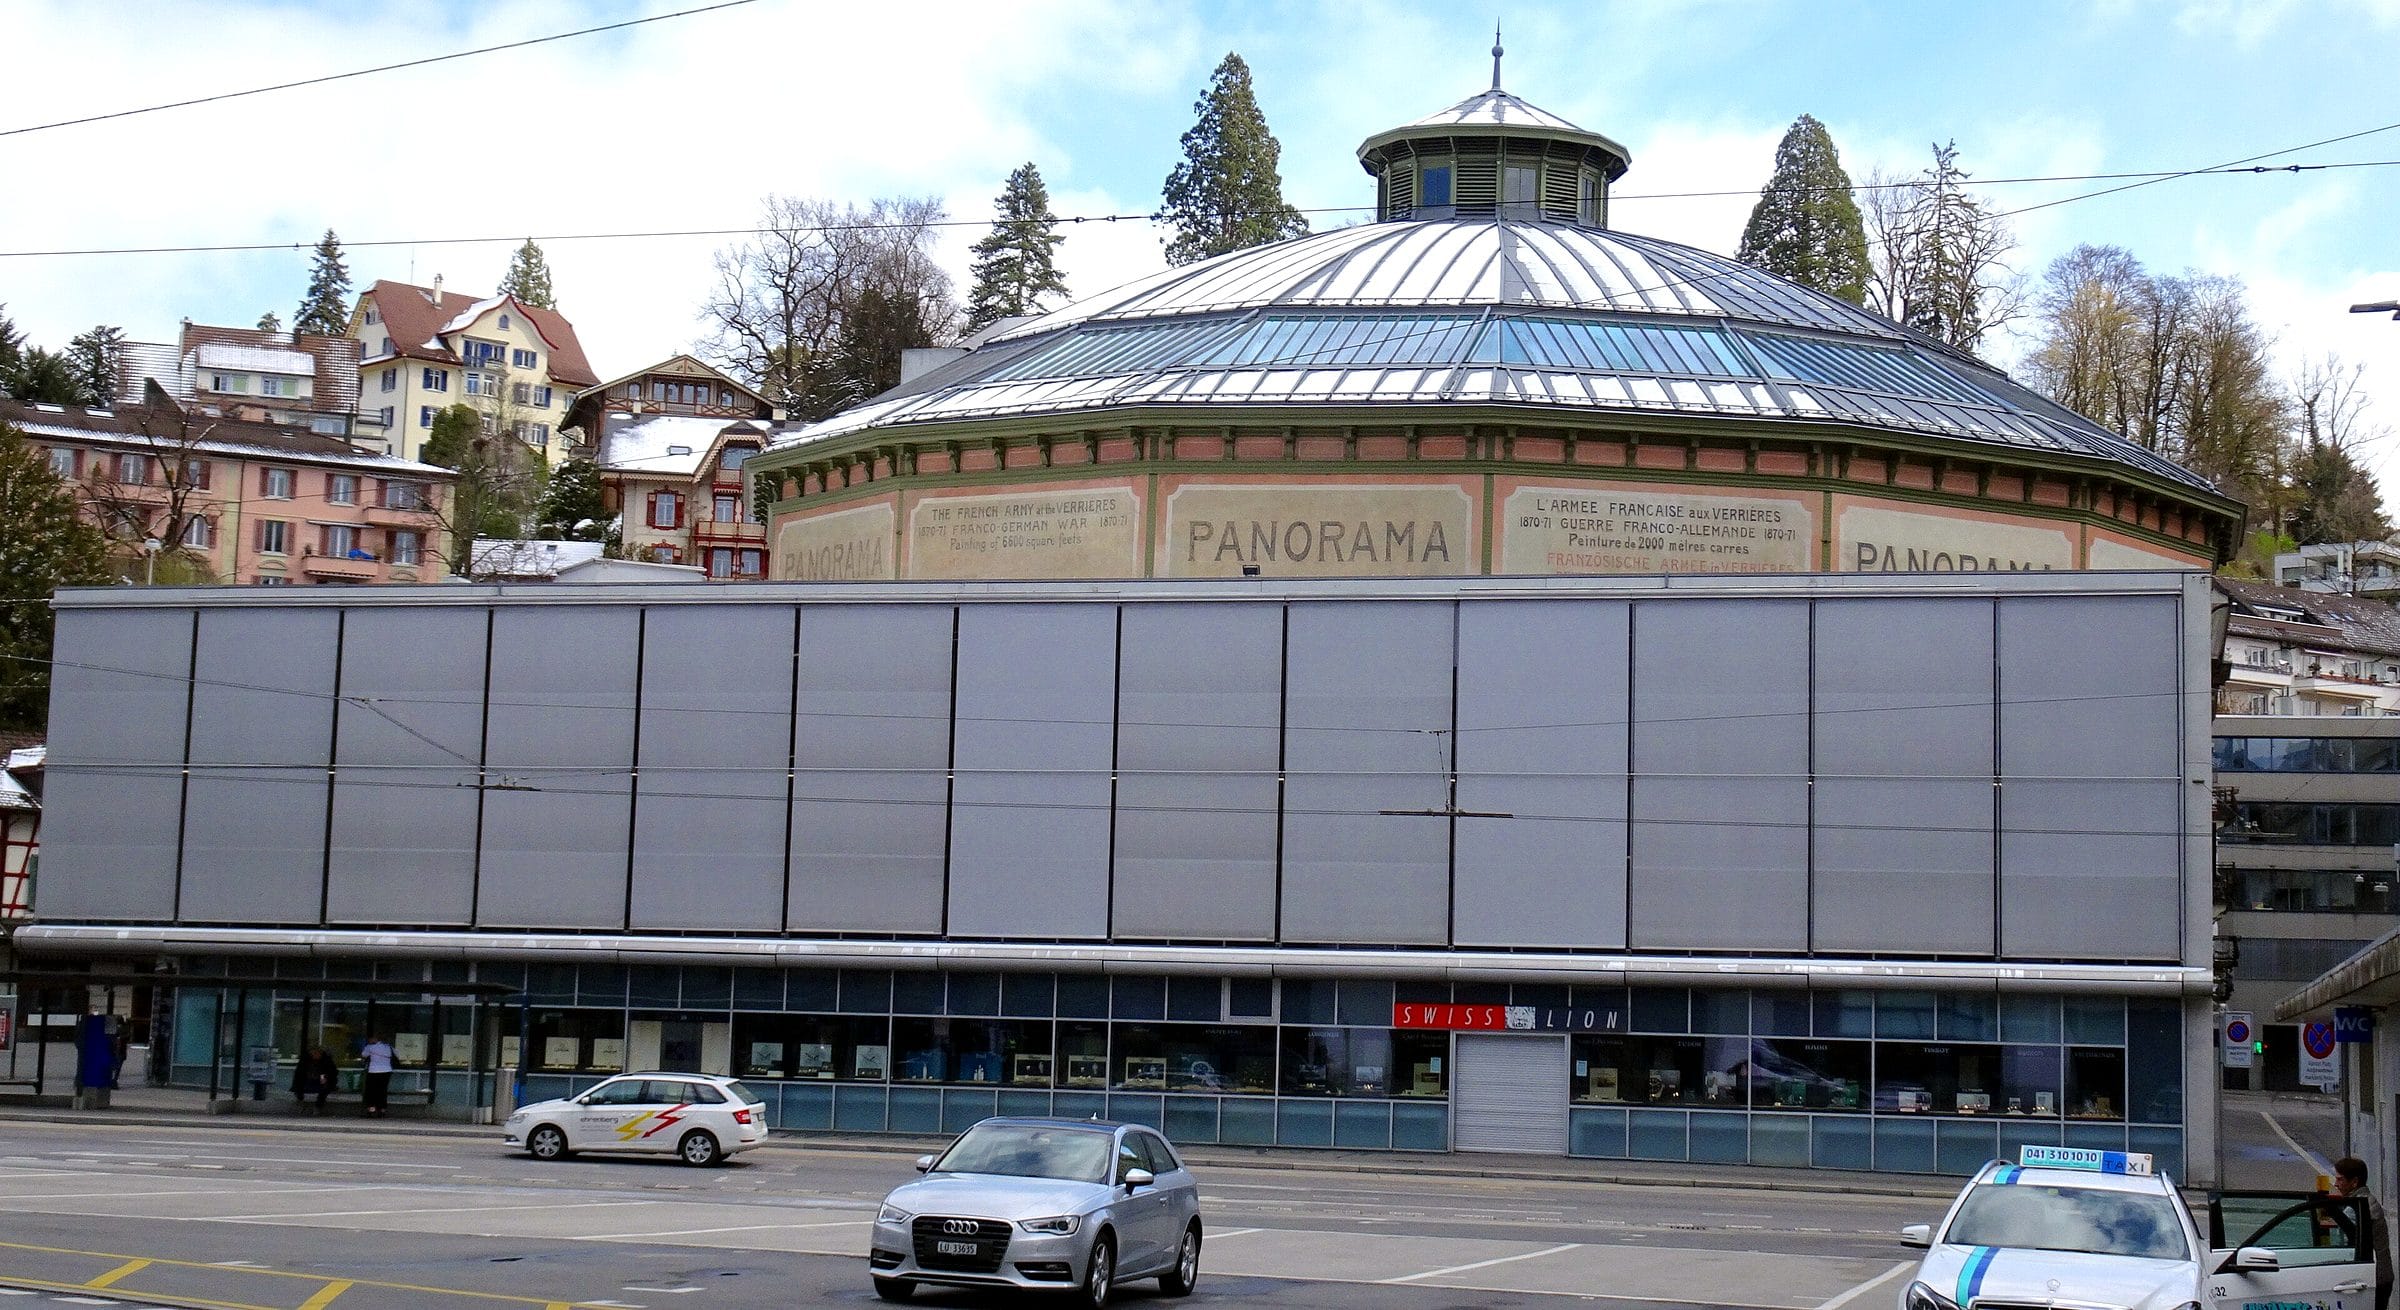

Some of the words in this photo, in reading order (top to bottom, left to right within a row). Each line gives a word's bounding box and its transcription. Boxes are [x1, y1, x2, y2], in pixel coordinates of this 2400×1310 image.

[932, 508, 951, 521] THE
[957, 505, 999, 519] FRENCH
[1004, 503, 1035, 517] ARMY
[1689, 508, 1710, 520] aux
[917, 525, 947, 537] 1870-71
[1058, 517, 1088, 530] WAR
[1099, 515, 1128, 528] 1870-71
[1520, 516, 1552, 529] 1870-71
[1560, 518, 1614, 532] GUERRE
[1623, 520, 1756, 539] FRANCO-ALLEMANDE
[1764, 527, 1796, 541] 1870-71
[950, 536, 987, 553] Painting
[1058, 532, 1082, 548] feets
[1187, 520, 1451, 563] PANORAMA
[1569, 532, 1621, 549] Peinture
[1624, 536, 1636, 549] de
[1638, 536, 1665, 550] 2000
[783, 536, 883, 579] PANORAMA
[1403, 1006, 1494, 1026] SWISS
[1546, 1009, 1618, 1030] LION
[2333, 1016, 2369, 1031] WC
[2026, 1148, 2045, 1159] 041
[2104, 1160, 2145, 1172] TAXI
[939, 1243, 950, 1252] LU
[2214, 1286, 2227, 1297] 32
